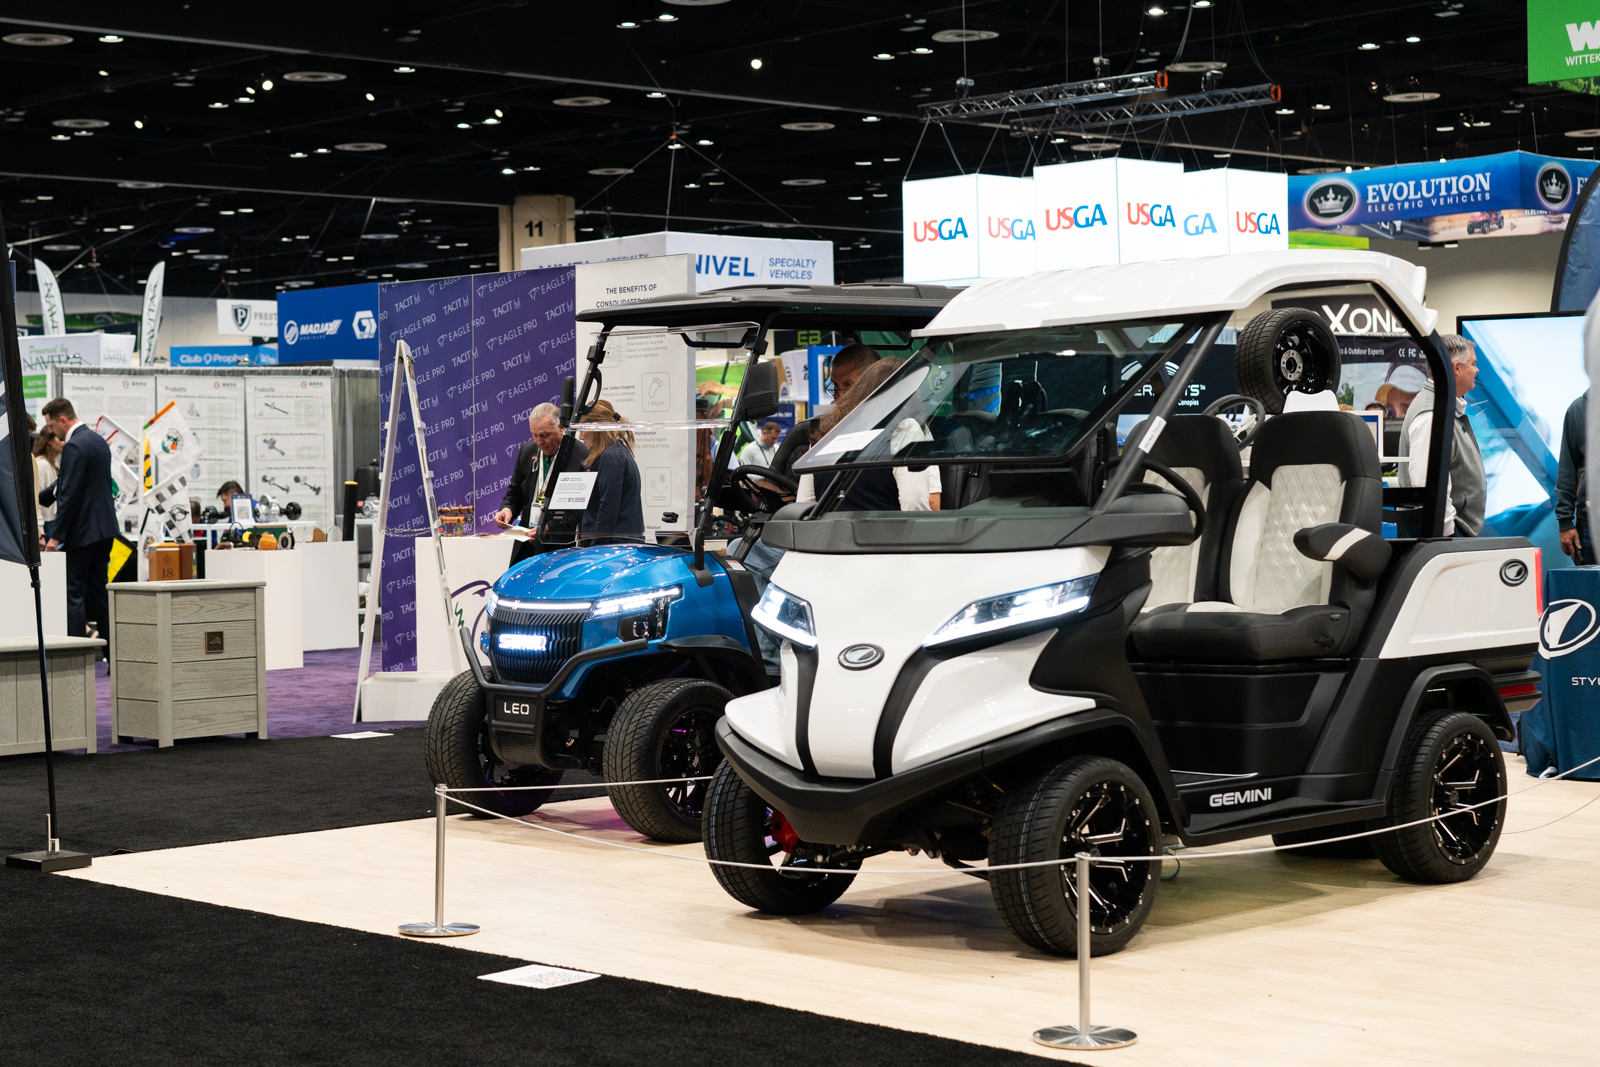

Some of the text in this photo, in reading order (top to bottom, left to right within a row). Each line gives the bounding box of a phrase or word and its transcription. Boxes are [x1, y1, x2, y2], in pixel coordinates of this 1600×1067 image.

[1565, 53, 1600, 66] WITTEK
[1366, 172, 1491, 204] EVOLUTION
[1367, 192, 1490, 213] ELECTRIC VEHICLES
[1045, 204, 1108, 231] USGA
[1127, 202, 1176, 227] USGA
[1236, 211, 1281, 235] USGA
[525, 220, 544, 237] 11
[913, 217, 969, 243] USGA
[987, 216, 1036, 241] USGA
[1184, 213, 1218, 236] GA
[769, 257, 817, 269] SPECIALTY
[488, 273, 512, 292] EAGLE
[540, 270, 576, 294] EAGLE PR
[769, 269, 812, 280] VEHICLES
[619, 285, 647, 294] BENEFITS
[394, 296, 413, 312] TACIT
[443, 298, 462, 315] TACIT
[492, 301, 513, 318] TACIT
[545, 303, 565, 321] TACIT
[380, 311, 388, 321] RO
[300, 320, 342, 336] MADJAX
[399, 313, 436, 338] EAGLE PRO
[448, 316, 485, 341] EAGLE PRO
[498, 319, 538, 345] EAGLE PRO
[551, 329, 576, 349] EAGLE
[180, 354, 202, 363] Club
[411, 346, 421, 358] CIT
[452, 350, 471, 367] TACIT
[1368, 348, 1384, 356] Experts
[22, 353, 70, 372] NAVIT
[502, 354, 522, 371] TACIT
[555, 358, 575, 375] TACIT
[415, 365, 445, 385] GLE PRO
[458, 369, 495, 394] EAGLE PRO
[508, 373, 548, 398] EAGLE PRO
[420, 398, 430, 410] CIT
[461, 403, 480, 419] TACIT
[512, 408, 532, 424] TACIT
[425, 417, 455, 437] GLE PRO
[466, 422, 504, 446] EAGLE PRO
[428, 450, 439, 463] CIT
[470, 456, 489, 472] TACIT
[390, 463, 416, 482] GLE PRO
[431, 469, 464, 489] AGLE PRO
[475, 481, 498, 500] EAGLE
[388, 496, 403, 510] ACIT
[412, 515, 425, 528] PRO
[479, 509, 499, 526] TACIT
[392, 548, 411, 563] TACIT
[162, 568, 173, 578] 18
[397, 575, 416, 590] EAGL
[401, 601, 416, 615] TACI
[504, 702, 530, 715] LEO
[1209, 787, 1272, 807] GEMINI
